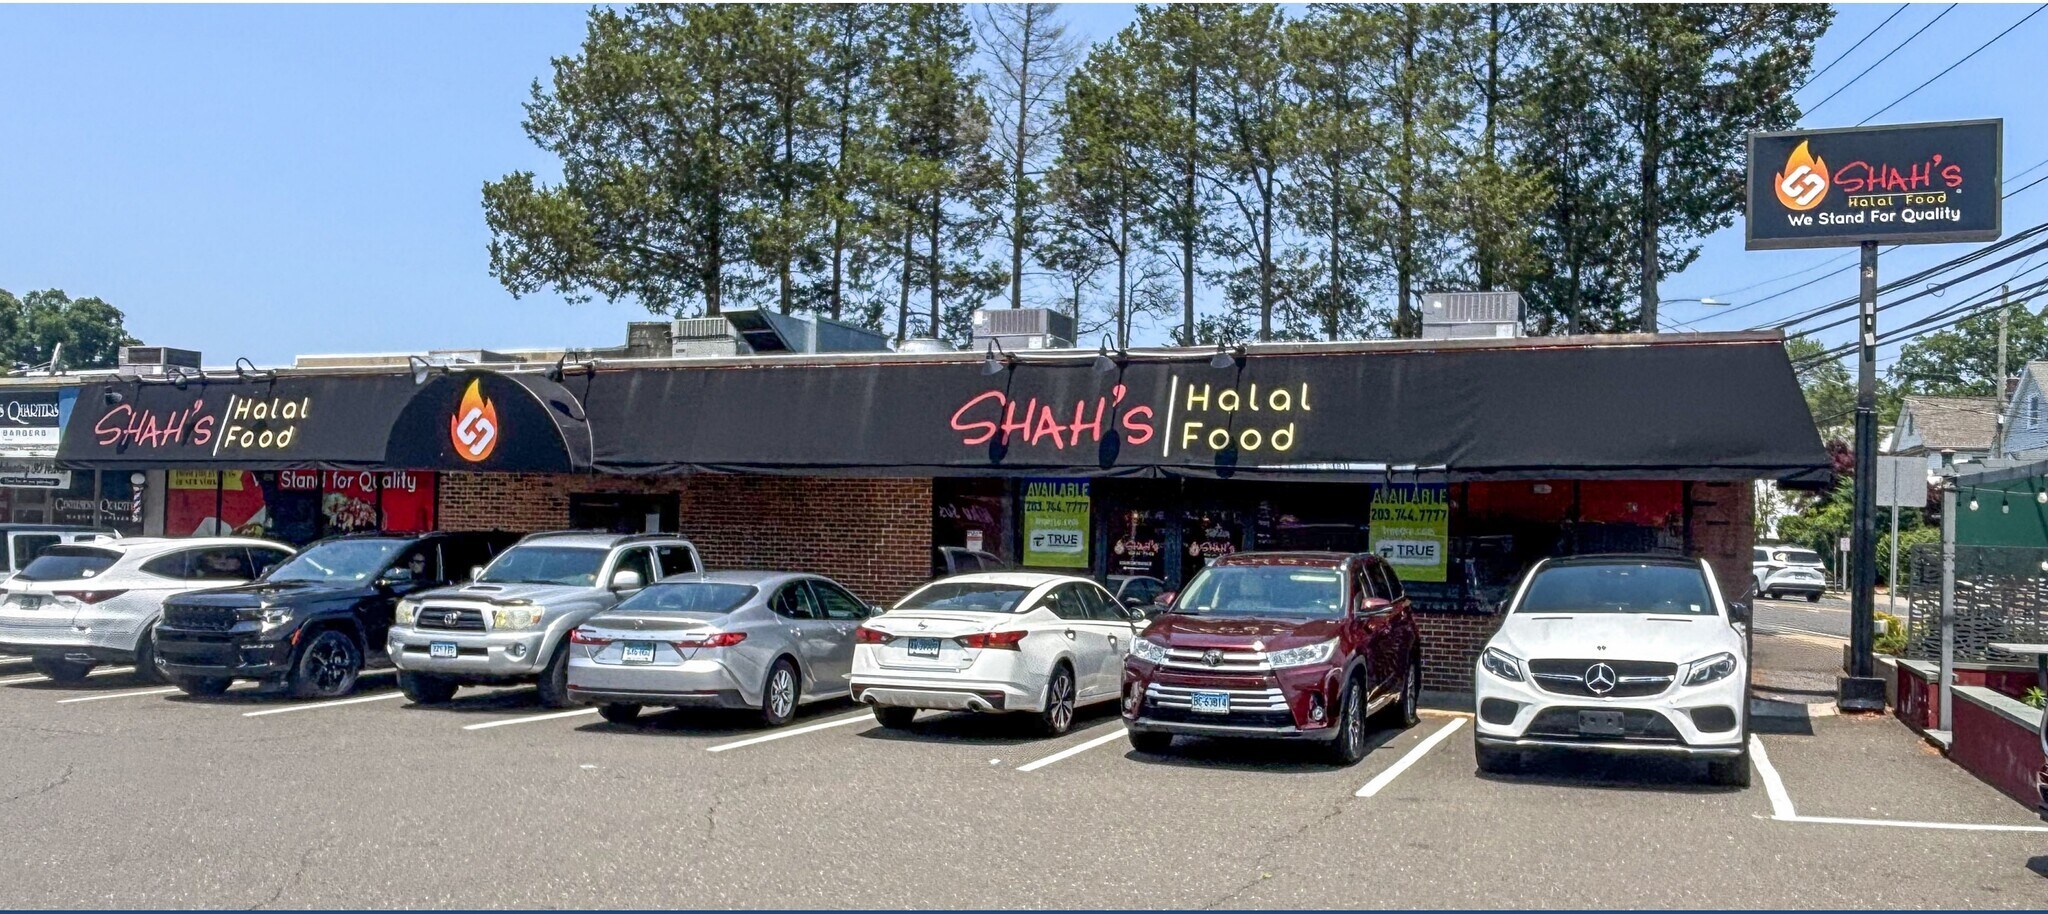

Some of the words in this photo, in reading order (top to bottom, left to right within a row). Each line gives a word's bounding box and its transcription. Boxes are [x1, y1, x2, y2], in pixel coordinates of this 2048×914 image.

[1833, 154, 1963, 193] SHAH'S
[1848, 193, 1894, 208] Halal
[1905, 193, 1947, 206] Food
[1788, 213, 1813, 227] We
[1818, 211, 1865, 225] Stand
[1870, 210, 1897, 223] For
[1901, 207, 1961, 223] Quality
[1186, 382, 1311, 412] Halal
[233, 397, 309, 421] Halal
[950, 383, 1155, 450] SHAH'S
[95, 400, 215, 448] SHAH'S
[223, 426, 295, 449] Food
[1182, 421, 1295, 451] Food
[333, 472, 354, 488] for
[1027, 482, 1090, 497] AVAILABLE
[1371, 508, 1447, 522] 203.744.7777
[1047, 534, 1078, 544] TRUE
[1397, 544, 1434, 556] TRUE
